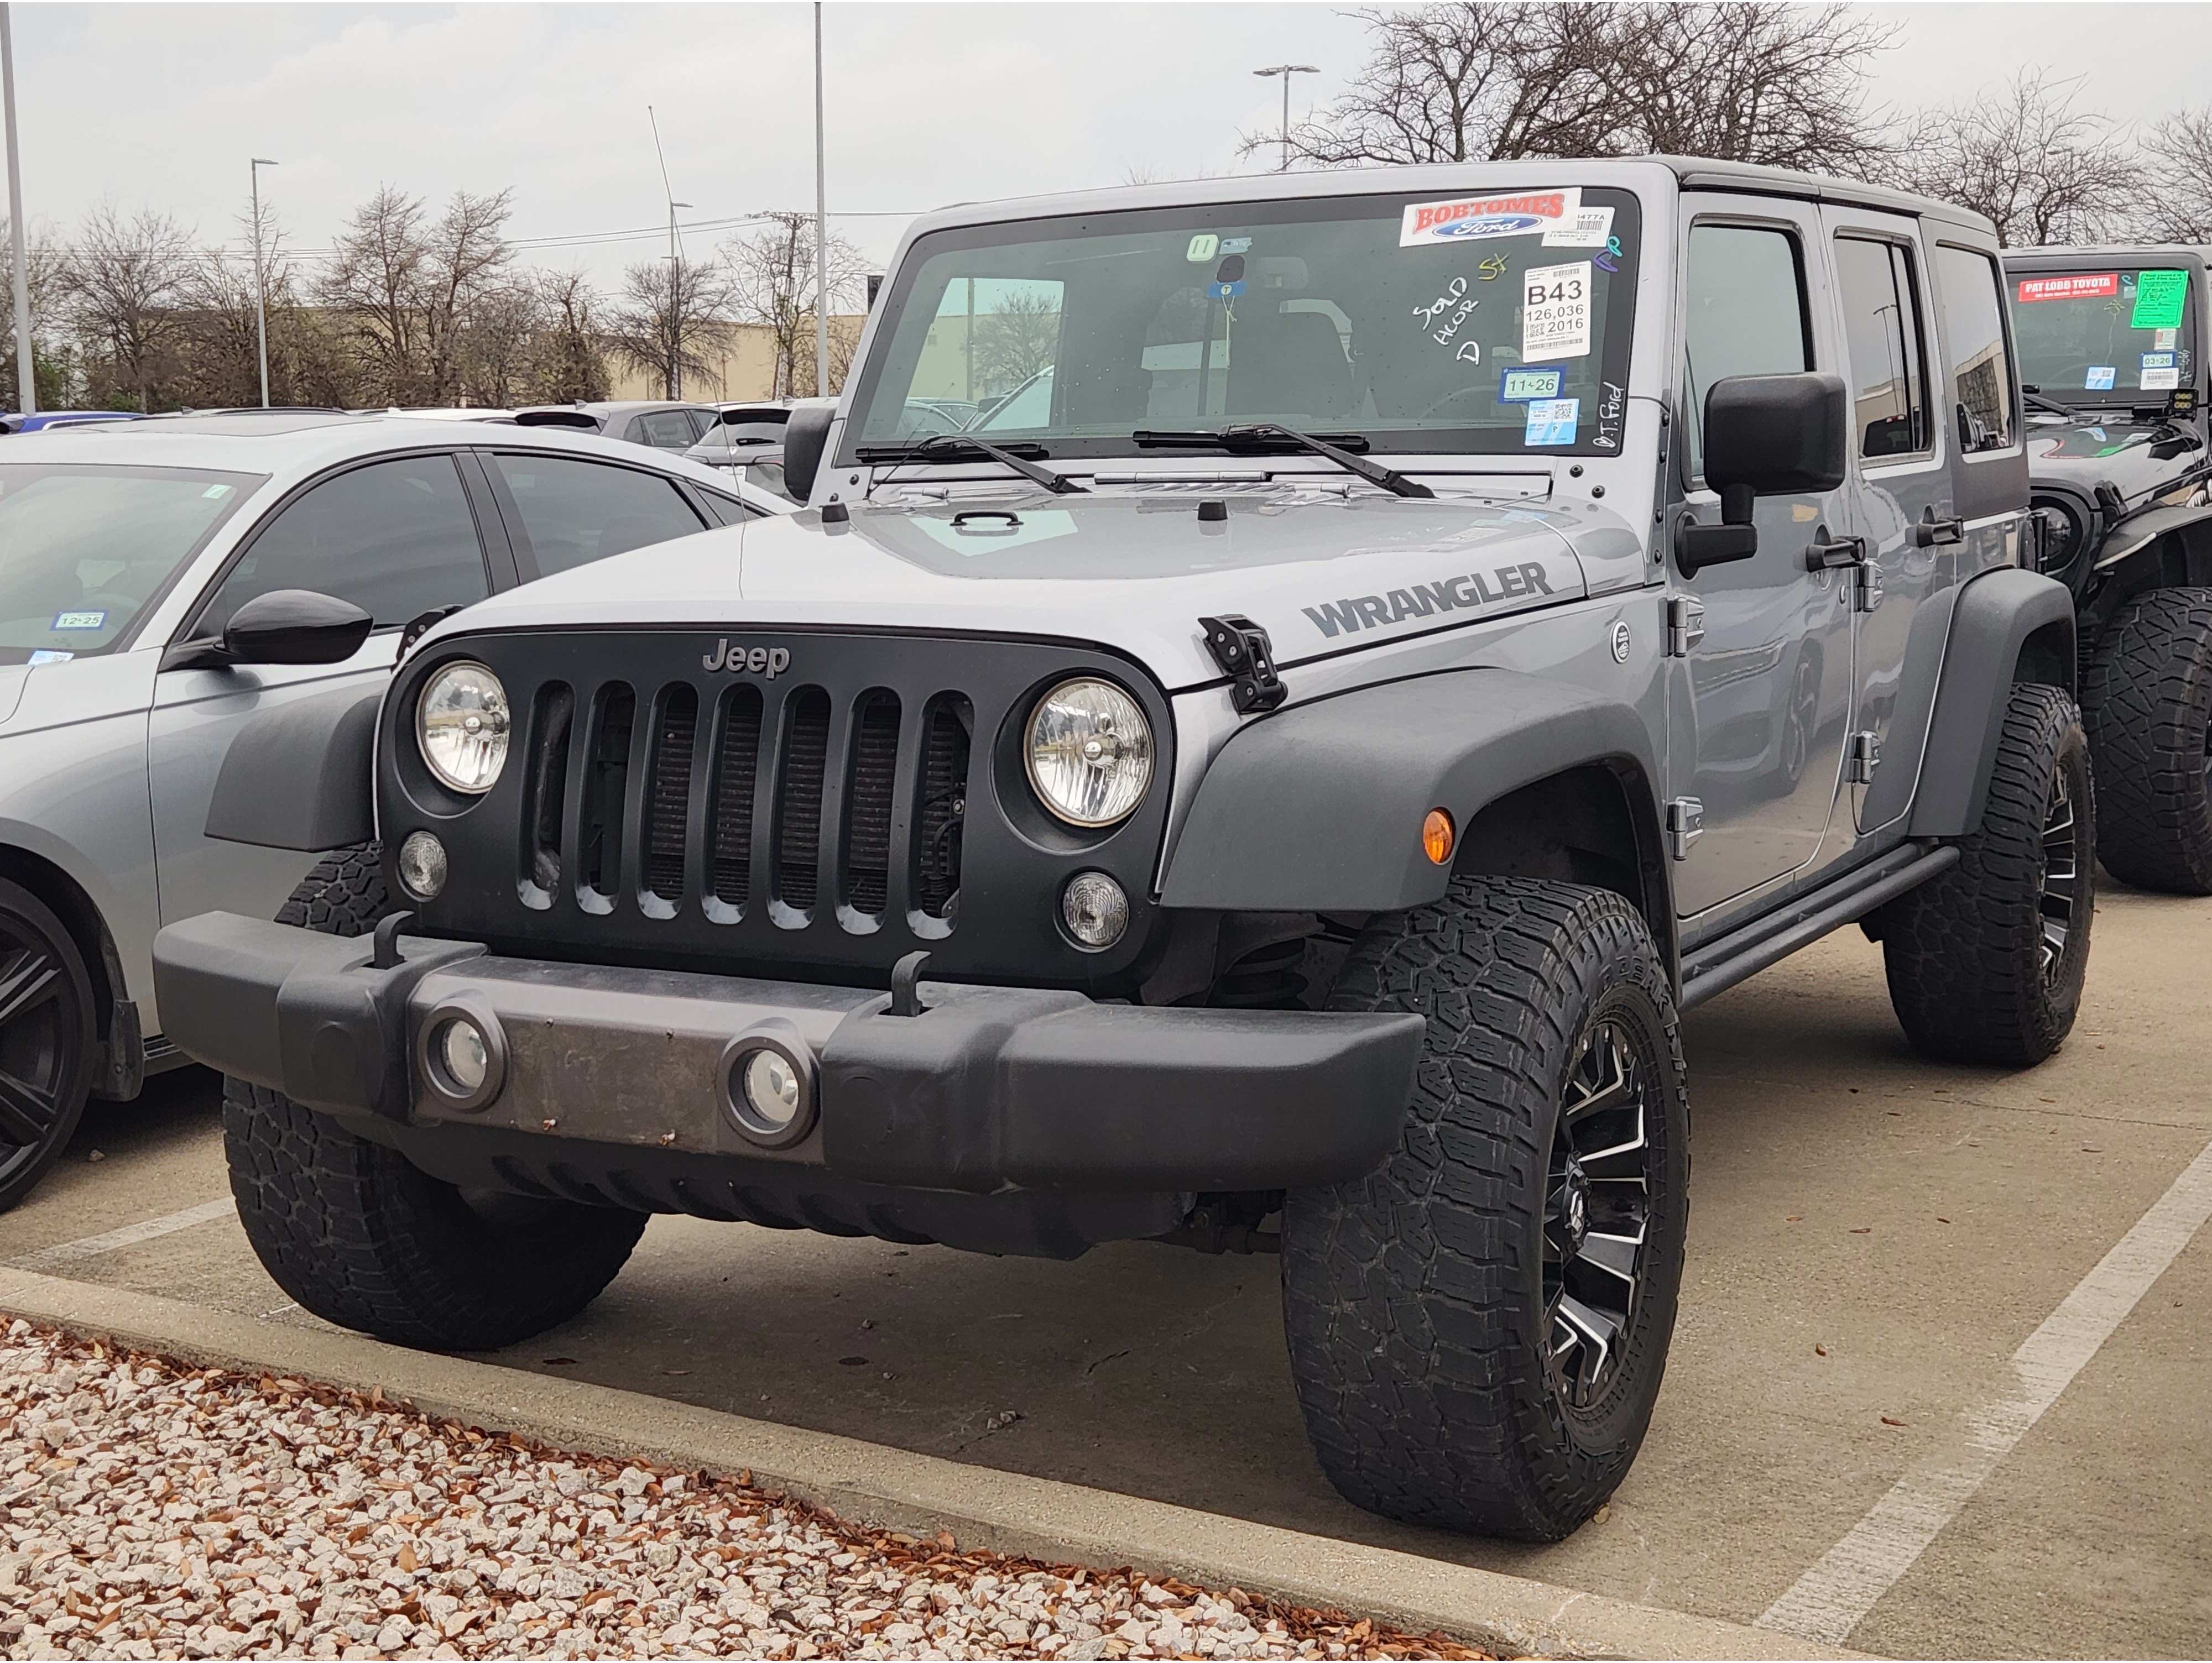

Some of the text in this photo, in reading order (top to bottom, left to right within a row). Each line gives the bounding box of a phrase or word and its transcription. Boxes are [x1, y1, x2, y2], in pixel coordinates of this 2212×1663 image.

[1453, 218, 1519, 236] Ford
[1528, 280, 1582, 306] B43
[2025, 282, 2044, 292] PAT
[2073, 277, 2111, 289] TOYOTA
[1526, 304, 1584, 322] 126,036
[1548, 318, 1583, 332] 2016
[1301, 562, 1554, 638] WRANGLER
[703, 638, 790, 679] Jeep
